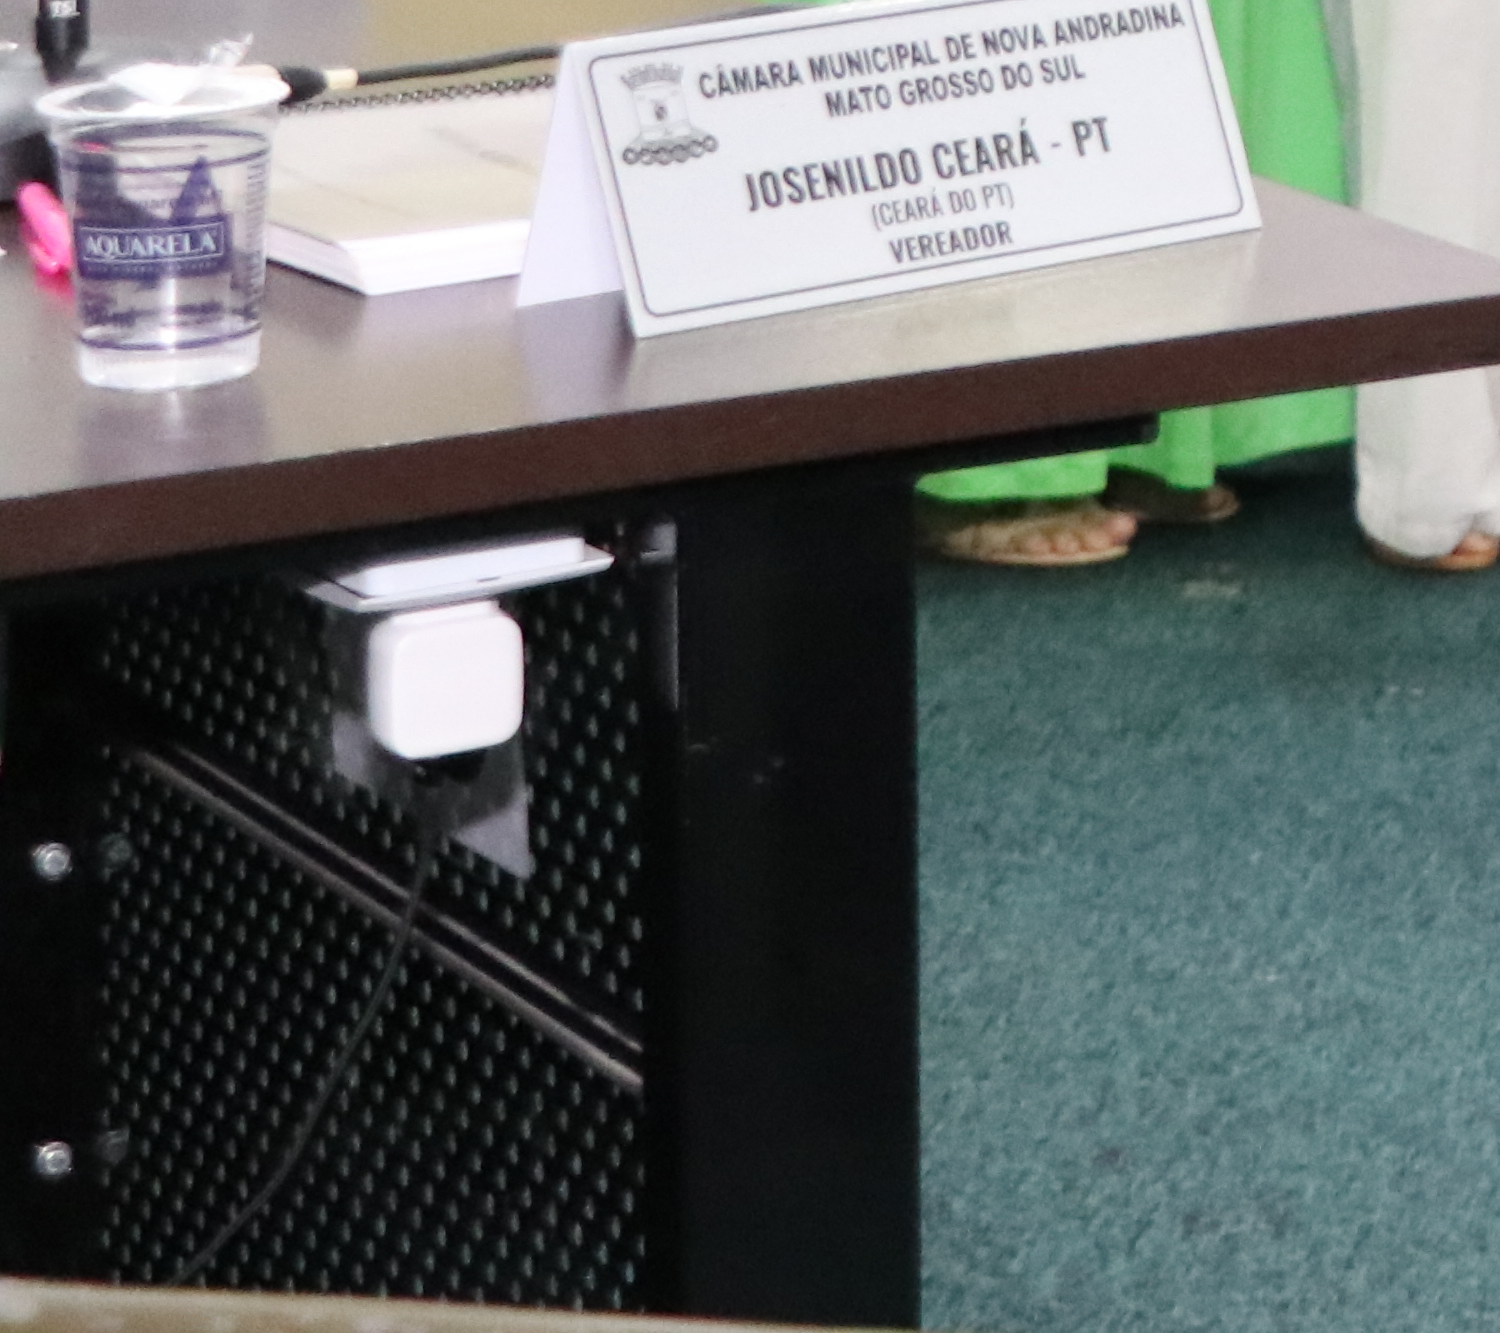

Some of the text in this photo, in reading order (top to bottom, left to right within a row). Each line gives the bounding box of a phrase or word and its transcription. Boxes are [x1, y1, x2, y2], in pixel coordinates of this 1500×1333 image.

[699, 1, 1186, 100] CÂMARA MUNICIPAL DE NOVA ANDRADINA
[825, 53, 1087, 119] MATO GROSSO DO SUL
[745, 146, 922, 212] JOSENILDO
[931, 117, 1042, 181] CEARÁ
[1070, 115, 1112, 158] PT
[870, 182, 1017, 232] (CEARÁ DO PT)
[84, 230, 218, 259] AQUARELA
[887, 220, 1015, 266] VEREADOR
